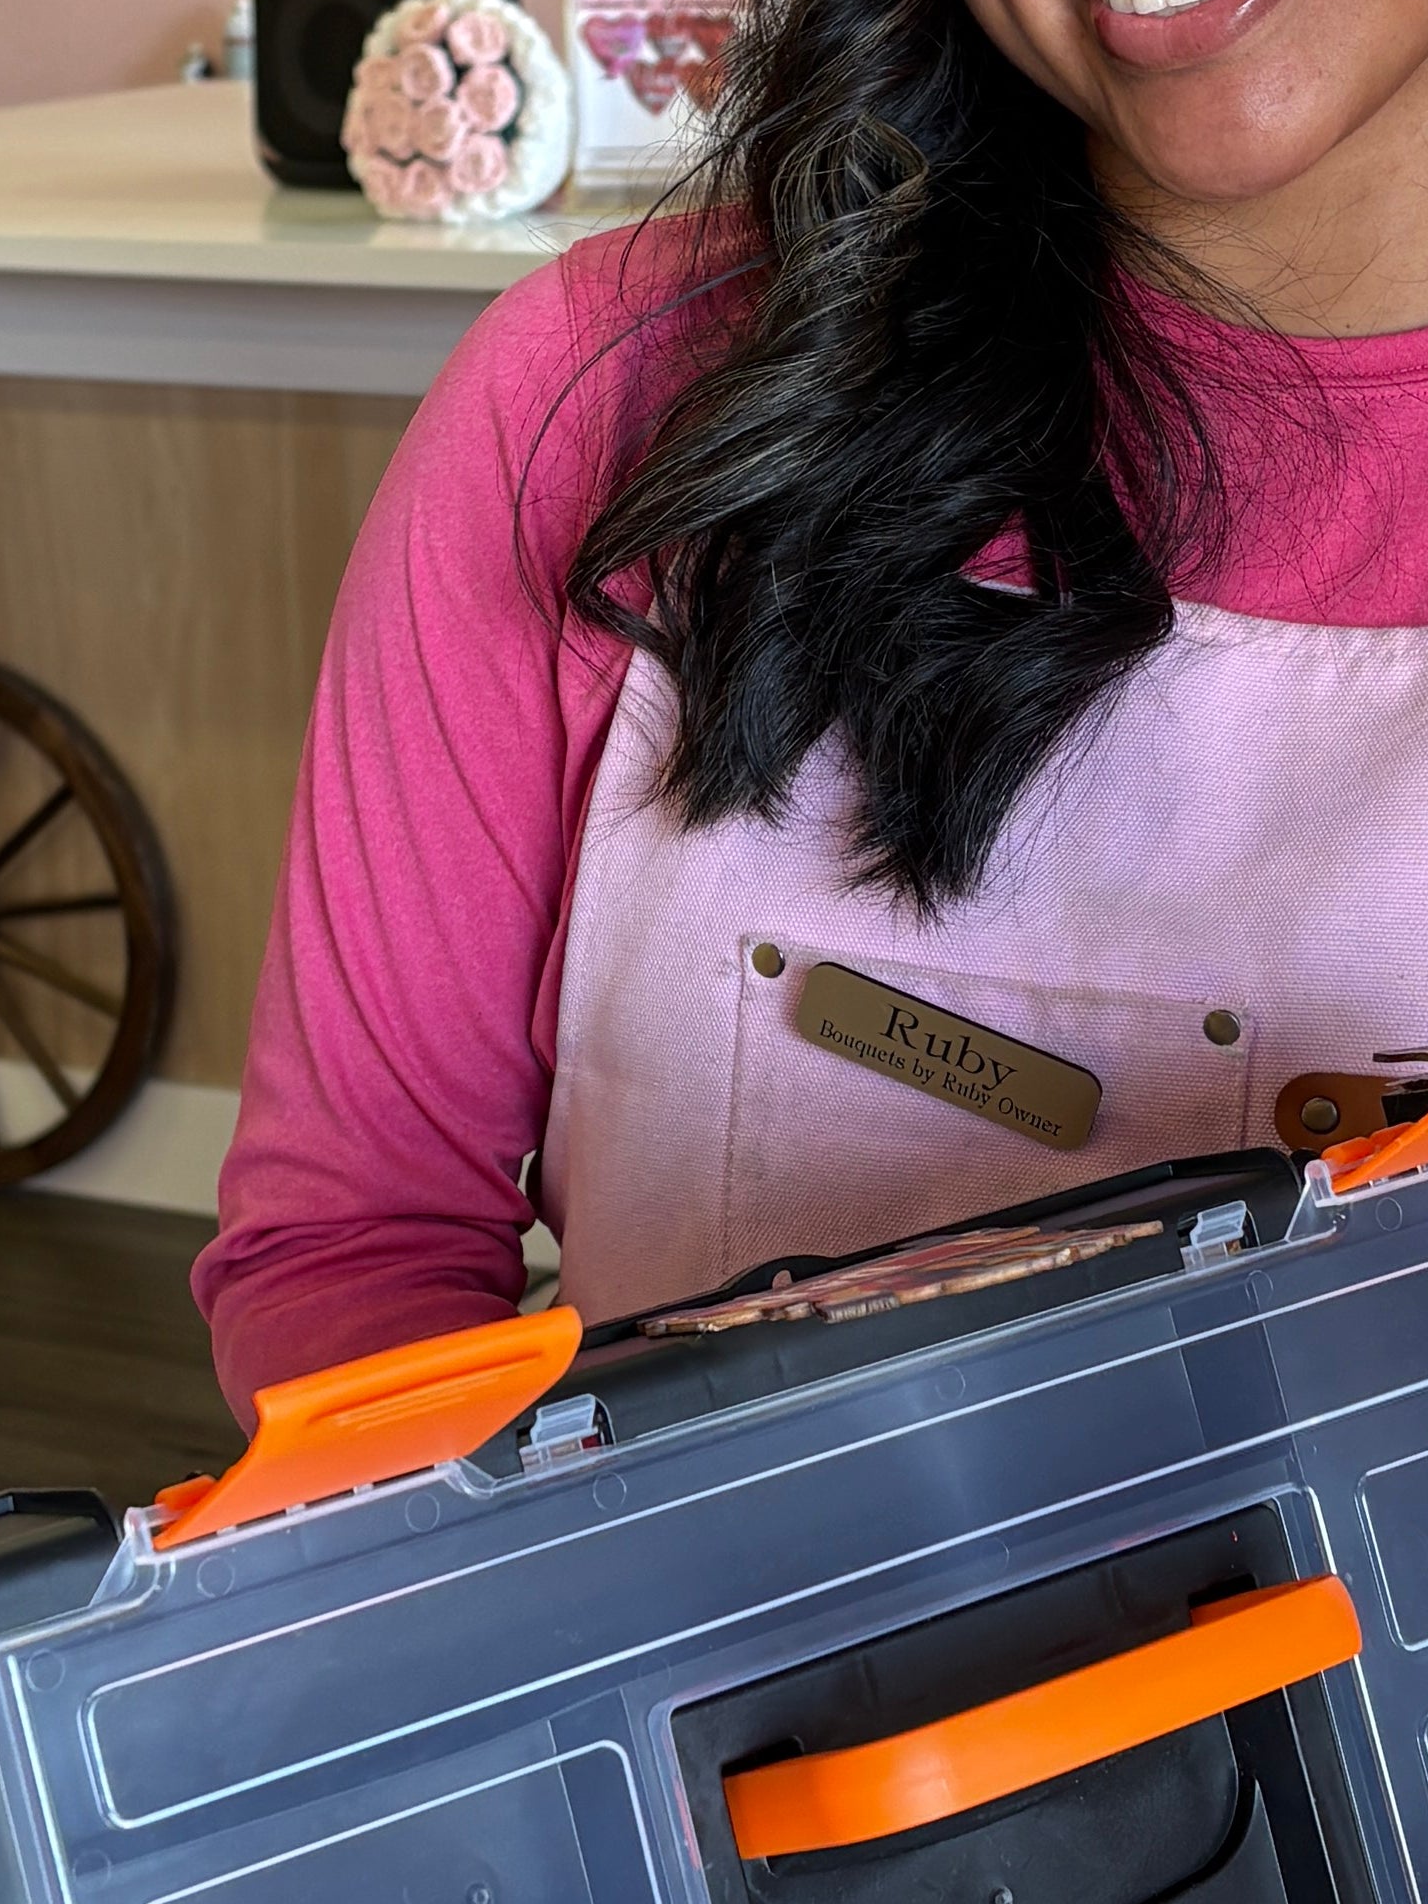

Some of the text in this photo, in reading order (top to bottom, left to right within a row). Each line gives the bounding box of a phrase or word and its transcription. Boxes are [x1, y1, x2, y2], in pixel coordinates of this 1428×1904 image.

[820, 1019, 1062, 1137] Bouquets by Ruby Owner
[878, 1002, 1018, 1091] Ruby
